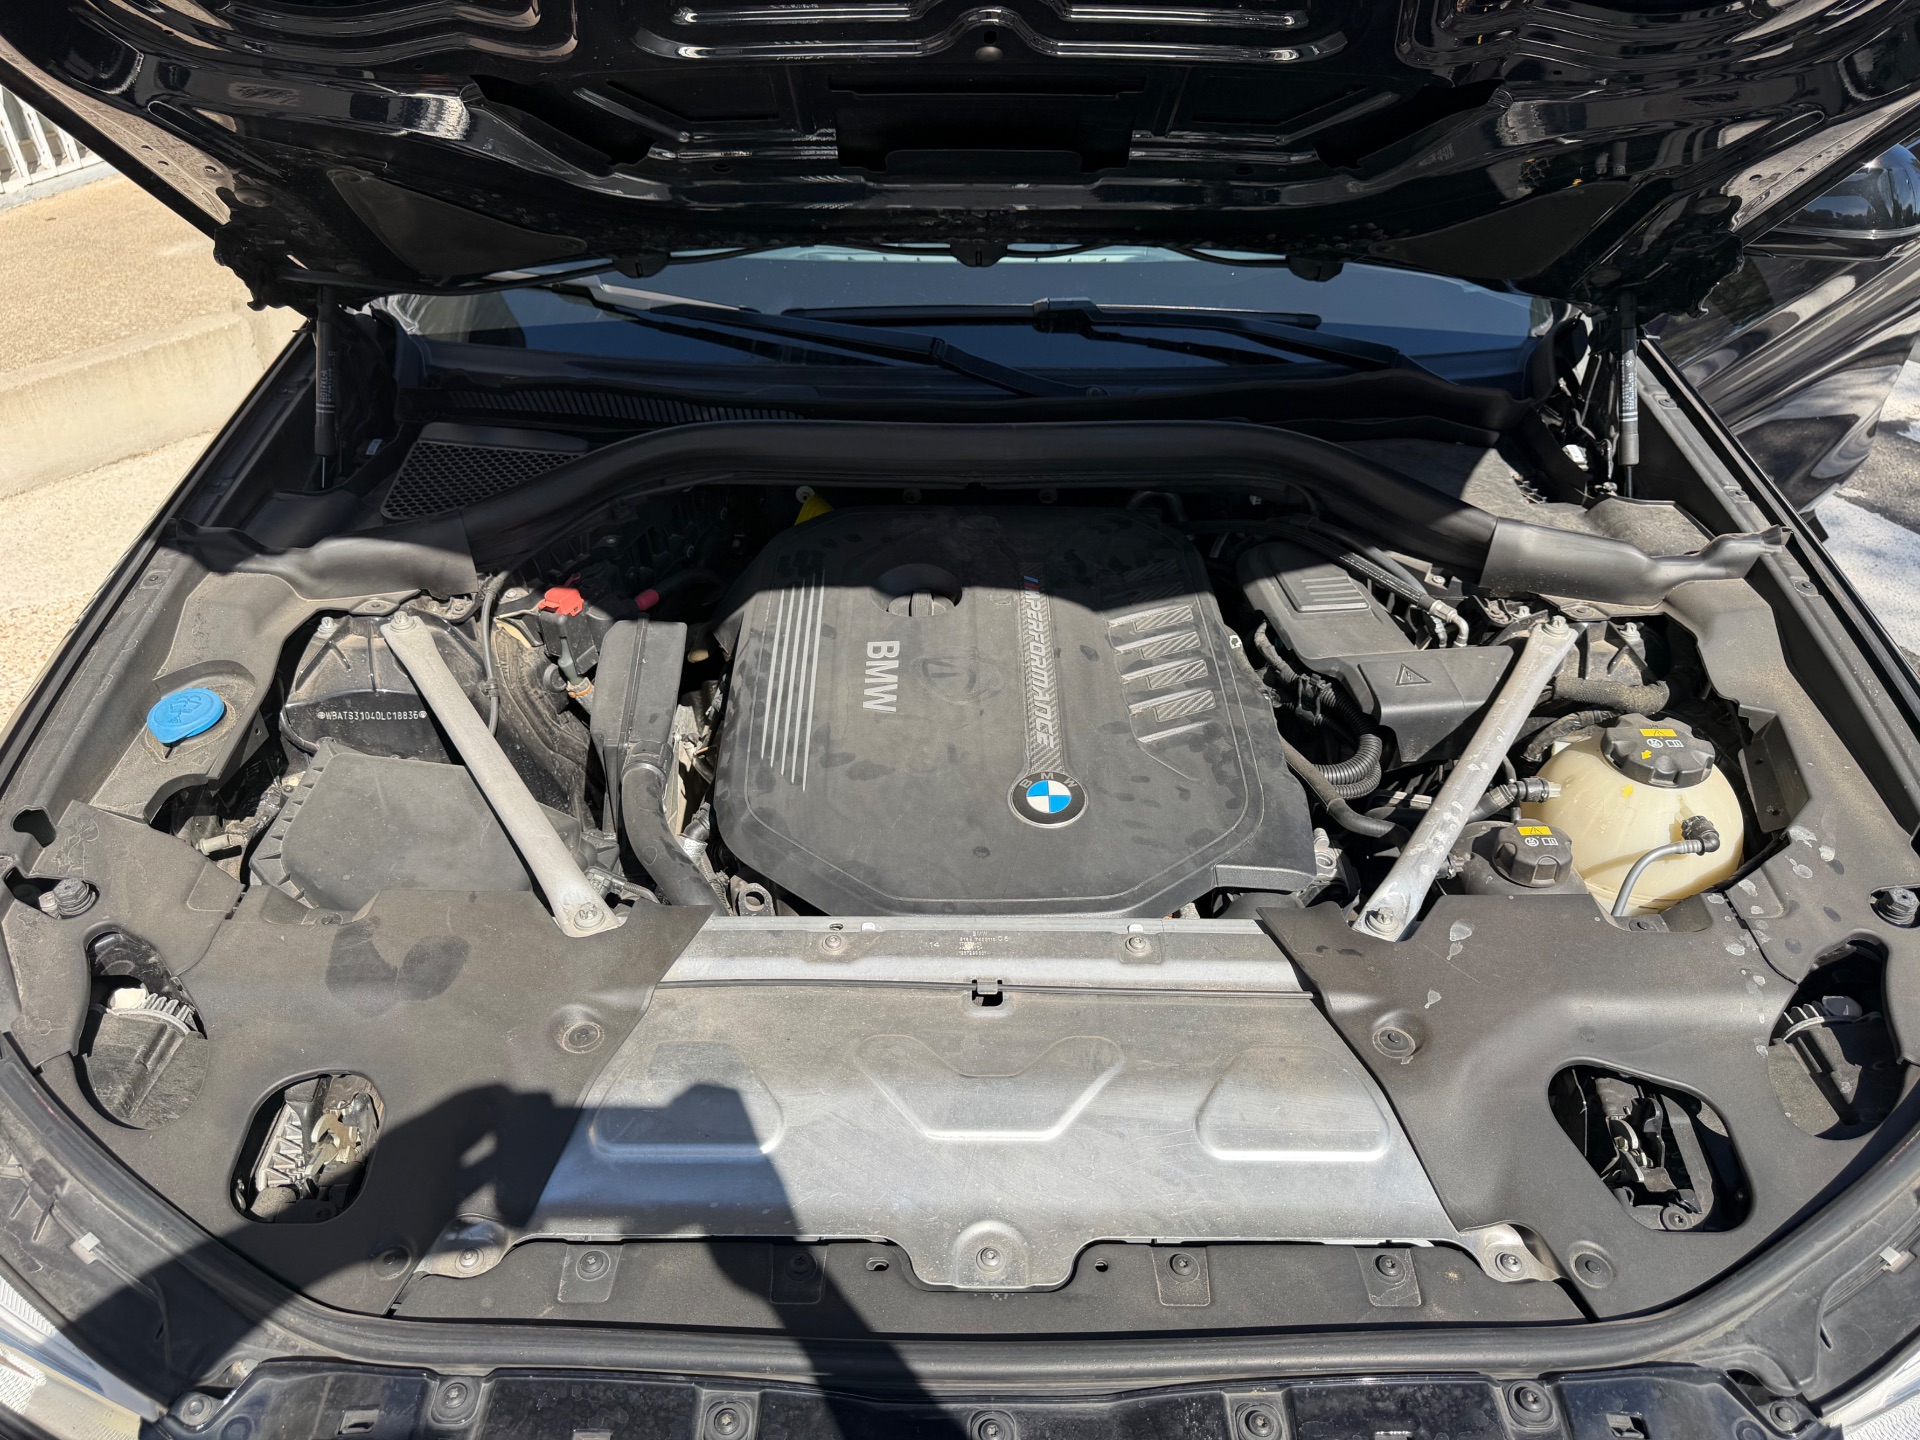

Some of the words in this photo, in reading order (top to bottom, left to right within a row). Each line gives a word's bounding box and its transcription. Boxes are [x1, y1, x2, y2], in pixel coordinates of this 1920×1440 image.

[862, 640, 901, 713] BMW
[1026, 598, 1055, 749] PERFORMANCE
[325, 710, 419, 721] WBATS31040LC18836
[1018, 771, 1078, 789] BMW
